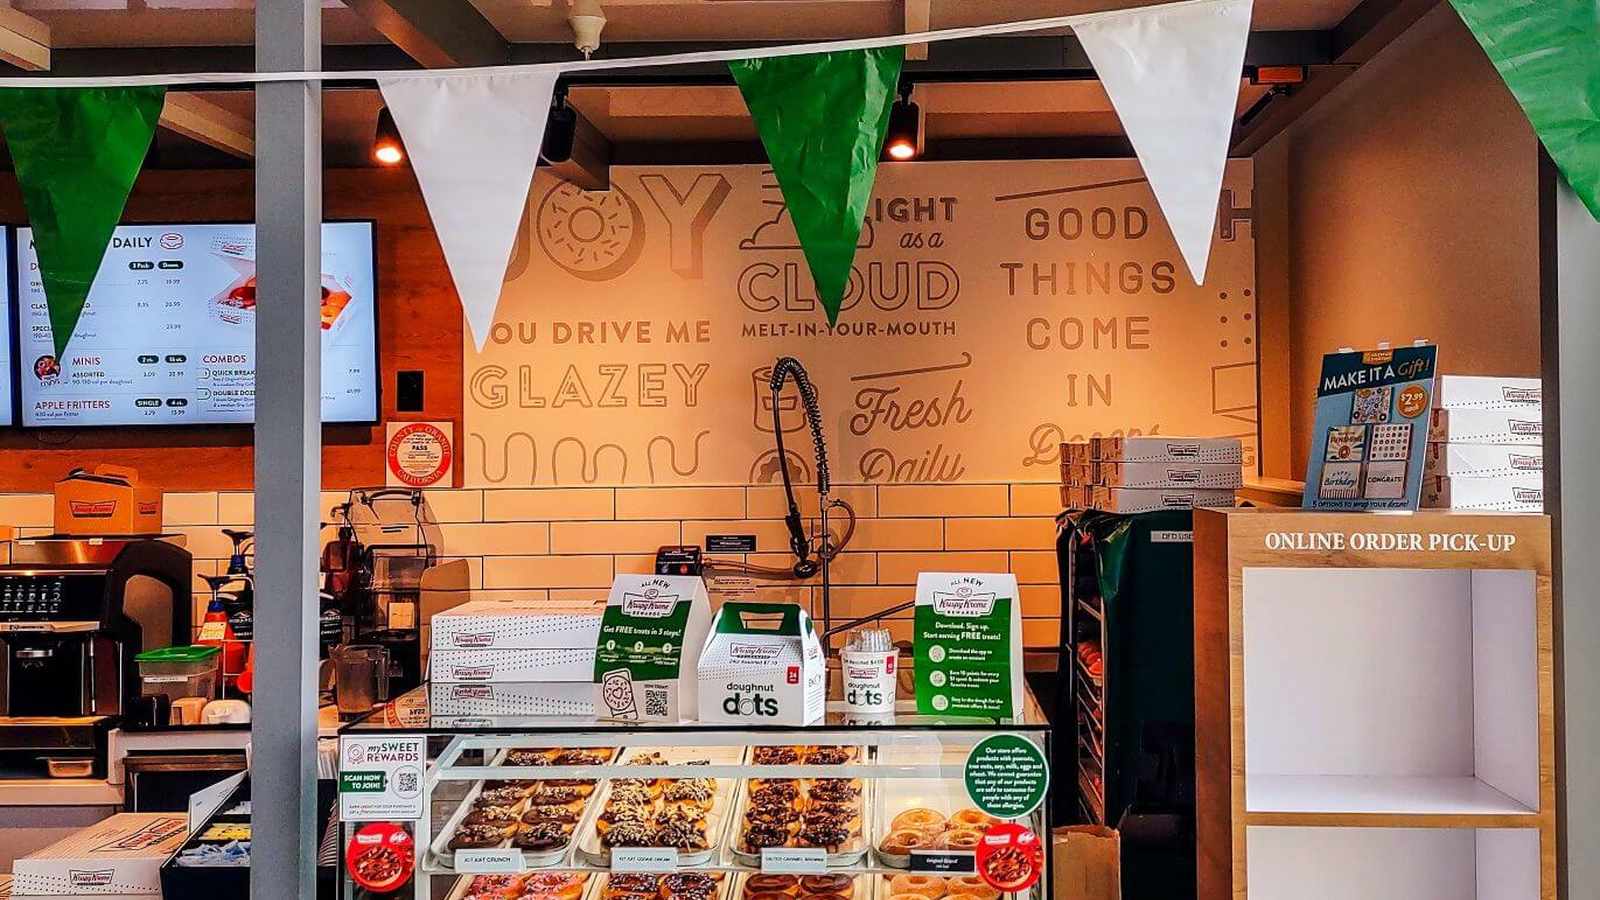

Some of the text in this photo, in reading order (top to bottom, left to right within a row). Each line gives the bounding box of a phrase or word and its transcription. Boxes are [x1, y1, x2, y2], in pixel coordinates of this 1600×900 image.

[875, 198, 958, 221] IGHT
[1025, 206, 1148, 240] GOOD
[113, 237, 152, 249] DAILY
[900, 232, 945, 248] as a
[1000, 261, 1175, 294] THINGS
[490, 320, 711, 344] OU DRIVE ME
[742, 322, 956, 337] MELT-IN-YOUR-MOUTH
[1026, 317, 1149, 350] COME
[72, 357, 101, 366] MINIS
[203, 355, 247, 364] COMBOS
[1324, 370, 1367, 391] MAKE
[1369, 366, 1382, 382] IT
[1384, 364, 1395, 379] A
[469, 364, 710, 409] GLAZEY
[1067, 374, 1112, 406] IN
[35, 400, 110, 410] APPLE FRITTERS
[850, 380, 972, 436] Fresh
[1265, 532, 1516, 552] ONLINE ORDER PICK-UP
[652, 579, 671, 589] NEW
[963, 577, 984, 586] NEW
[603, 625, 614, 633] Get
[615, 625, 633, 634] FREE
[939, 632, 960, 641] earning
[727, 683, 774, 693] doughnut
[723, 692, 779, 716] dots
[847, 689, 883, 705] dots
[367, 753, 419, 761] REWARDS
